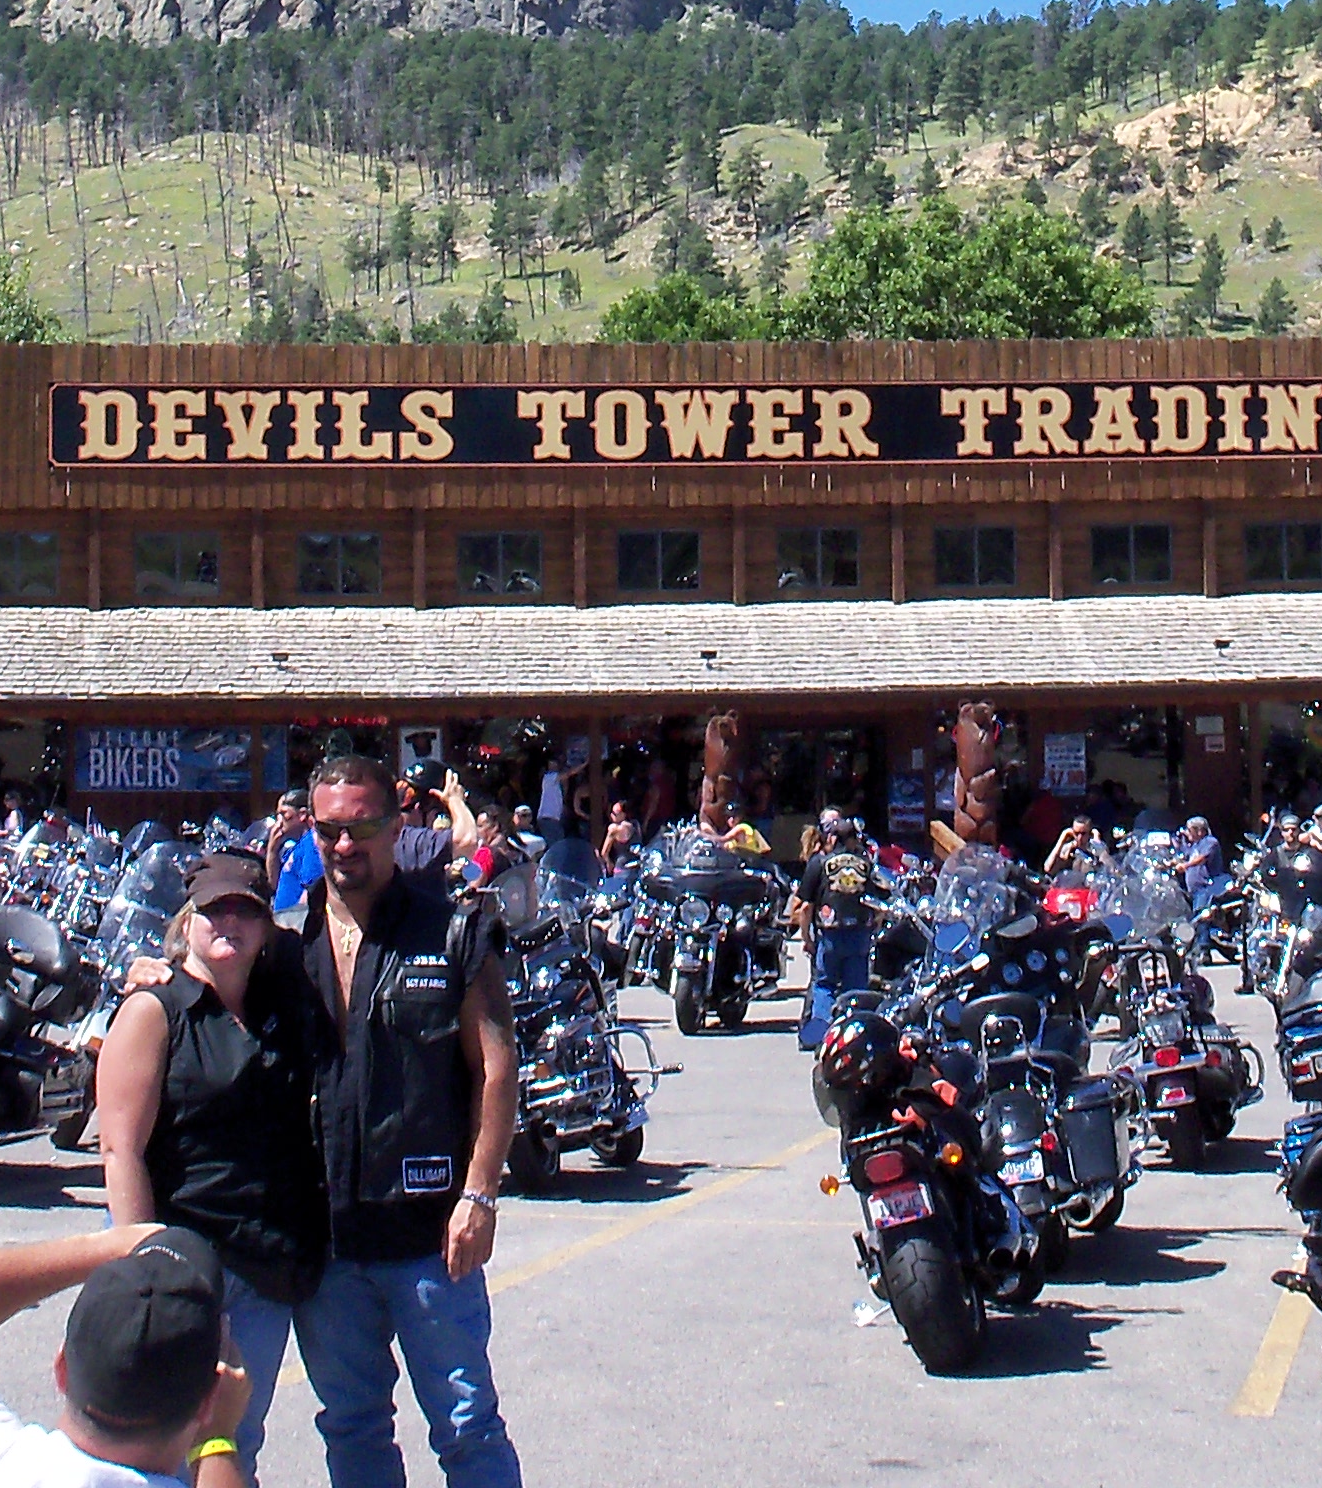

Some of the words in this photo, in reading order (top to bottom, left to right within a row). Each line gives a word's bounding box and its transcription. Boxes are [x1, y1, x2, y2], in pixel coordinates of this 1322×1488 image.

[77, 388, 455, 461] DEVILS
[515, 388, 880, 460] TOWER
[89, 730, 180, 748] WELCOME
[89, 748, 181, 788] BIKERS
